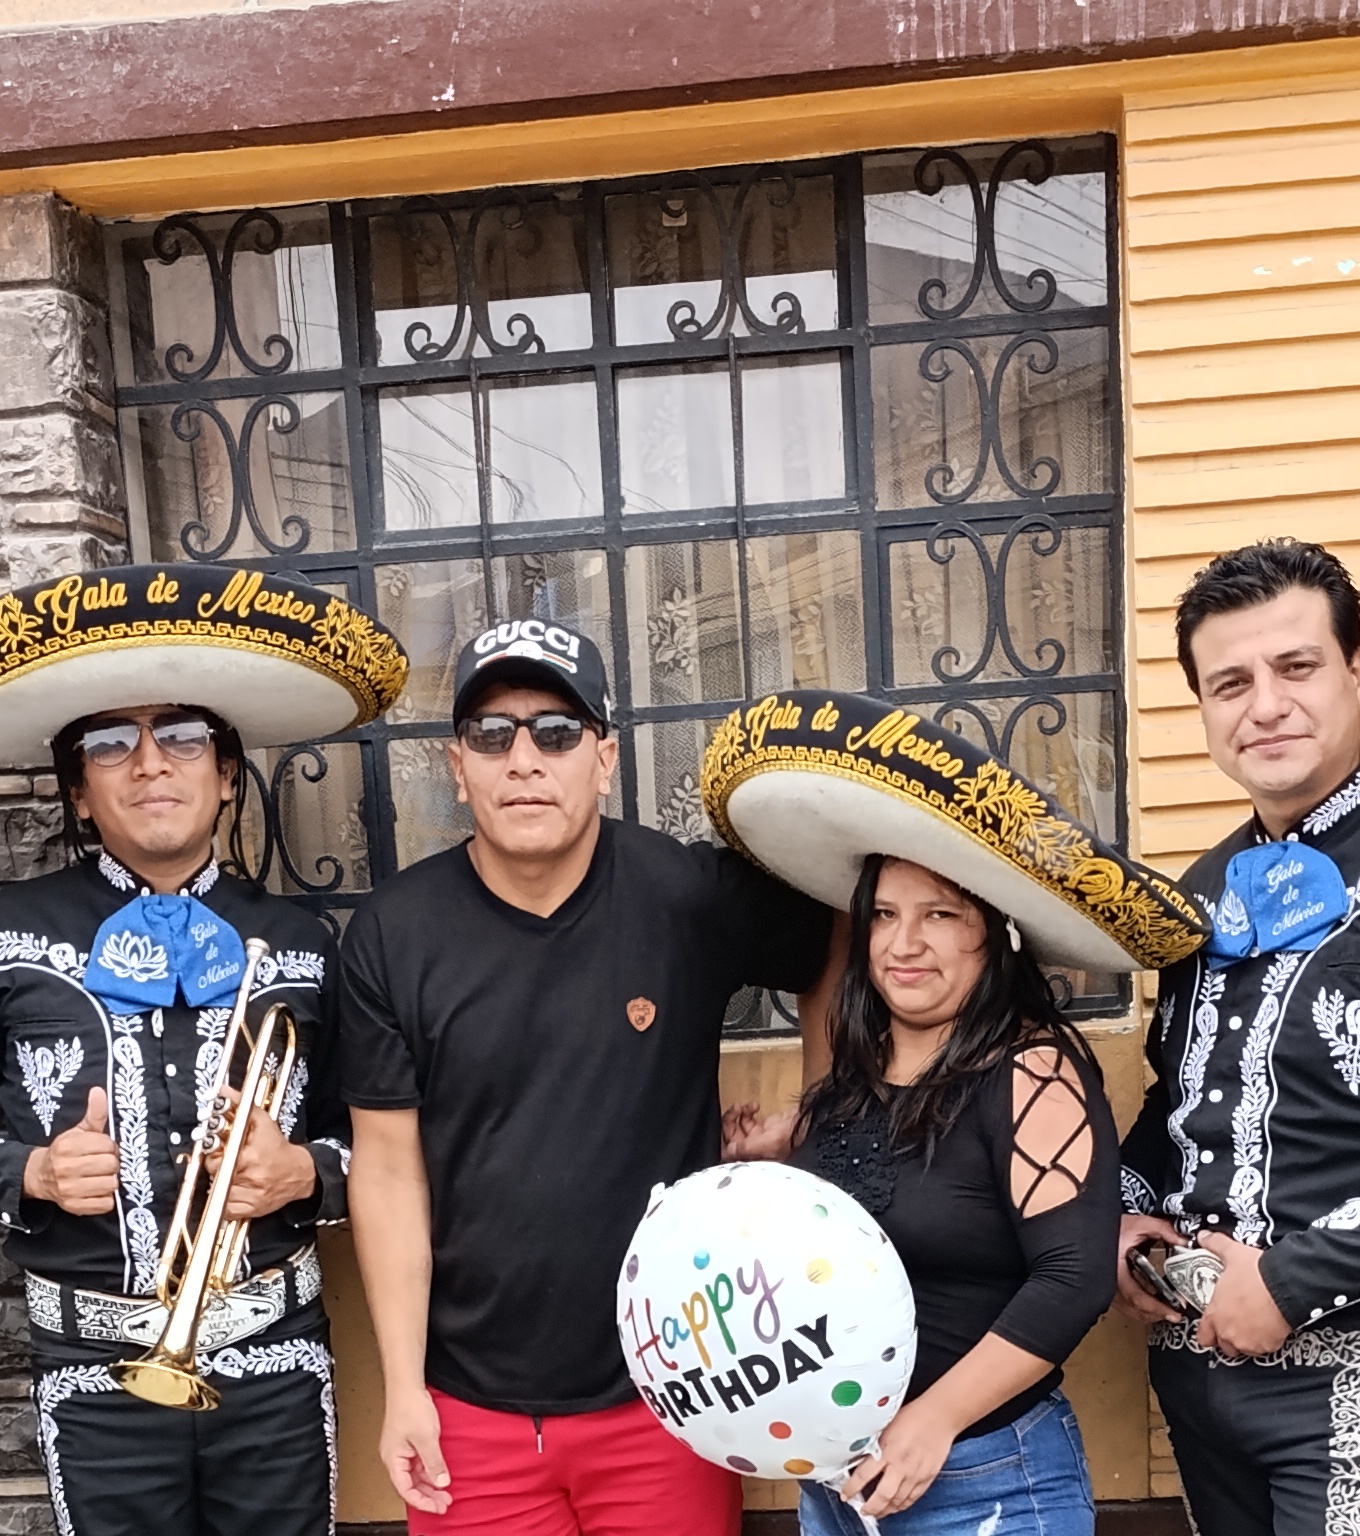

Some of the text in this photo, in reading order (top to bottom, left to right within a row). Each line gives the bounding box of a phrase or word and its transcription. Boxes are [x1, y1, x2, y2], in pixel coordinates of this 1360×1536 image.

[35, 569, 317, 634] Gala de Mexico
[473, 619, 581, 659] GUCCI
[746, 695, 963, 779] Gala de Mexico
[1266, 859, 1305, 894] Gala
[1282, 884, 1300, 906] de
[191, 921, 219, 949] Gala
[205, 943, 219, 962] de
[624, 1258, 785, 1383] Happy
[640, 1313, 835, 1428] BIRTHDAY
